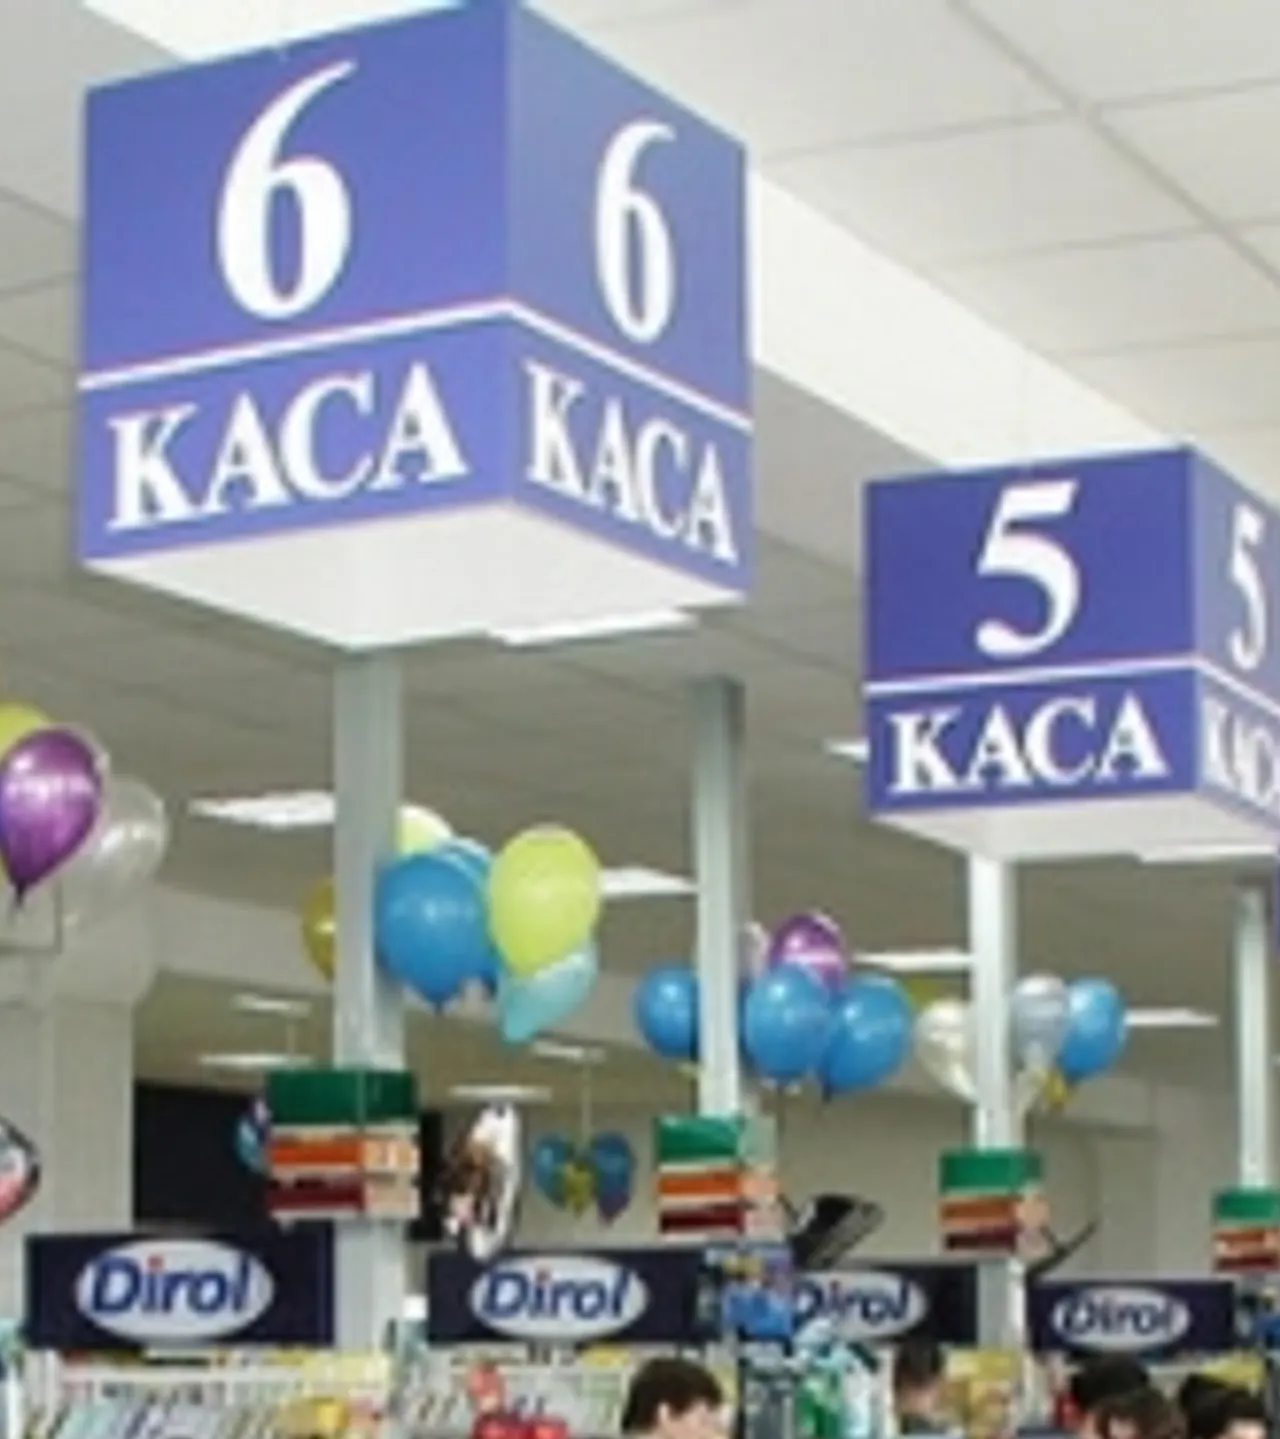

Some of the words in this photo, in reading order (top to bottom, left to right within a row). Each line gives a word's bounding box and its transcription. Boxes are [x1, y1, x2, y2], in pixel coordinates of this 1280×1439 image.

[219, 61, 356, 319] 6
[595, 119, 675, 343] 6
[106, 361, 470, 532] КАСА
[524, 359, 738, 564] КАСА
[975, 480, 1078, 657] 5
[1230, 504, 1266, 671] 5
[888, 693, 1168, 794] КАСА
[92, 1252, 253, 1314] Dirol
[482, 1264, 630, 1320] Dirol
[1063, 1289, 1176, 1334] Dirol
